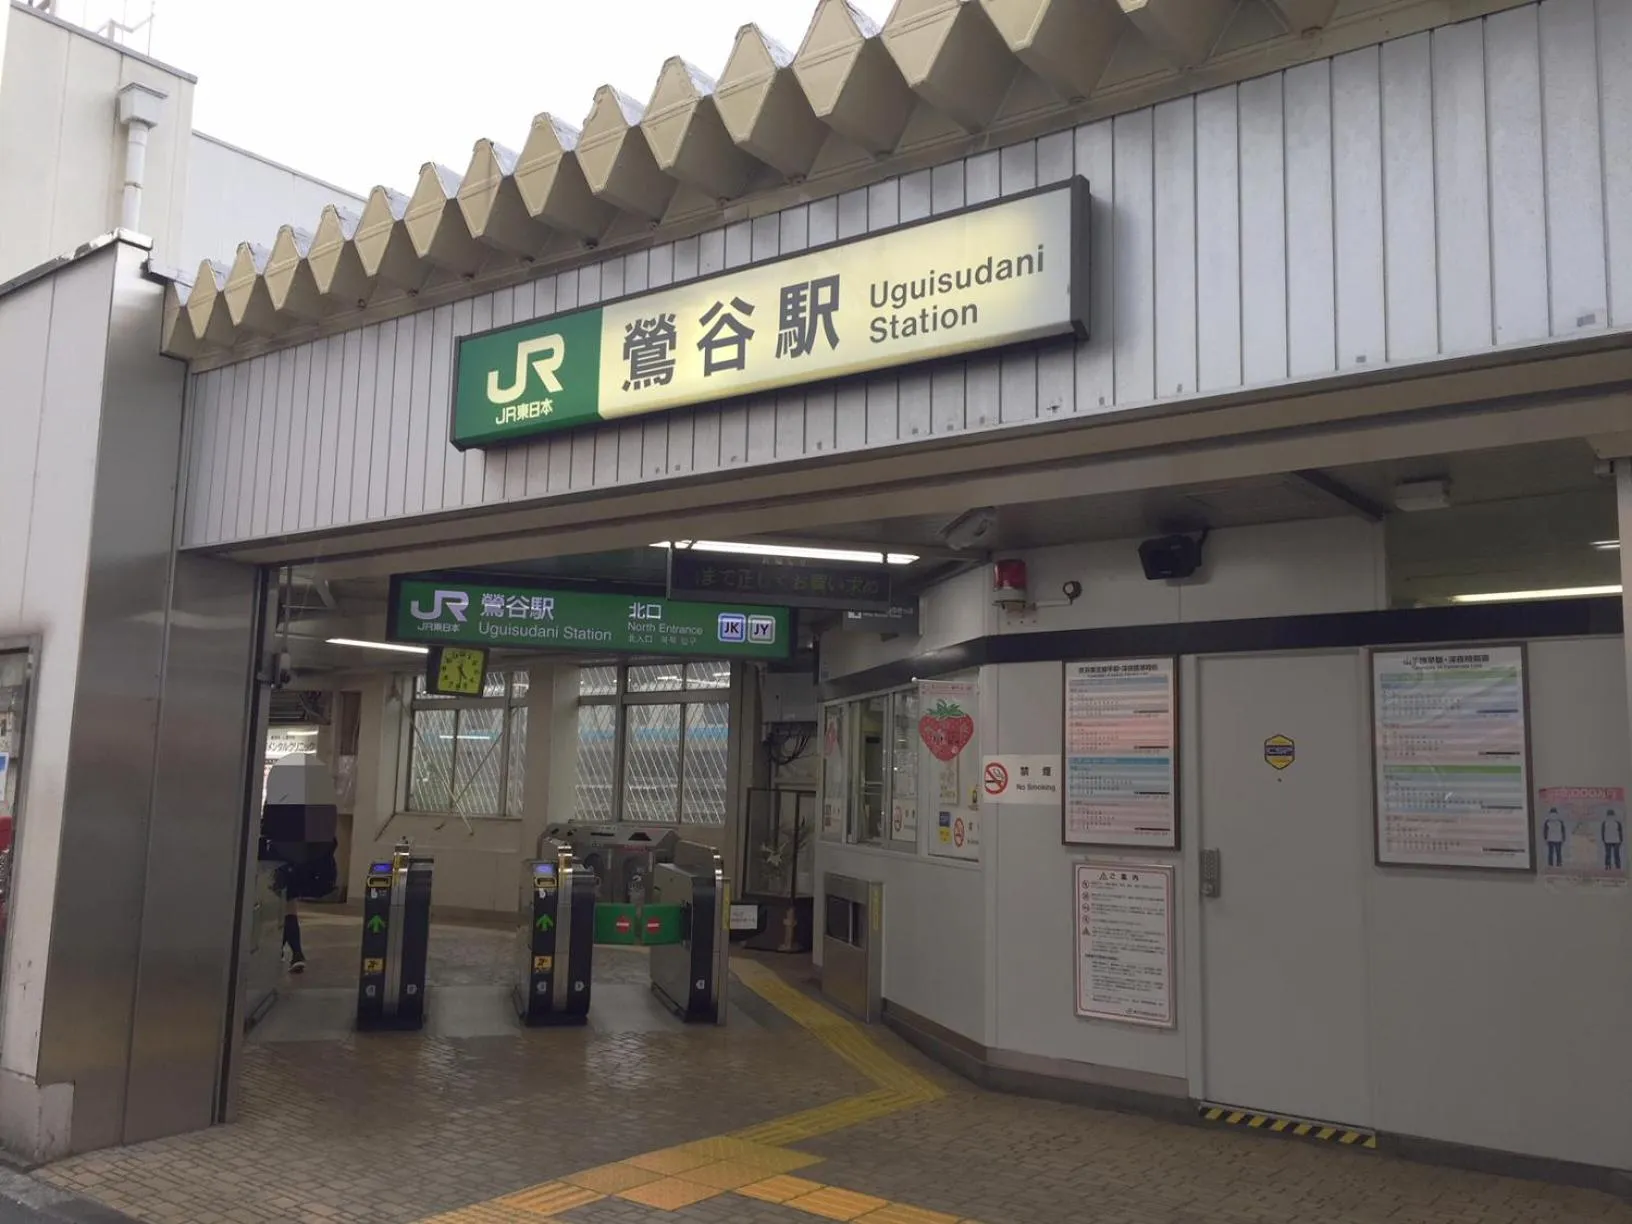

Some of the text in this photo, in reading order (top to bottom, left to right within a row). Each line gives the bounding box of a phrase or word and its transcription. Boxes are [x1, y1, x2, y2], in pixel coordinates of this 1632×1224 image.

[869, 243, 1045, 310] Uguisudani
[620, 273, 841, 393] 鶯谷駅
[869, 302, 979, 345] Station
[486, 332, 566, 402] JR
[495, 398, 554, 426] JR東日本
[410, 589, 470, 622] JR
[480, 593, 555, 621] 鶯谷駅
[628, 602, 662, 620] 北口
[417, 622, 461, 633] JR東日本
[478, 620, 612, 642] Uguisudani Station
[627, 621, 704, 636] North Entrance
[723, 621, 740, 634] JK
[753, 624, 769, 636] JY
[1016, 783, 1057, 793] No Smoking
